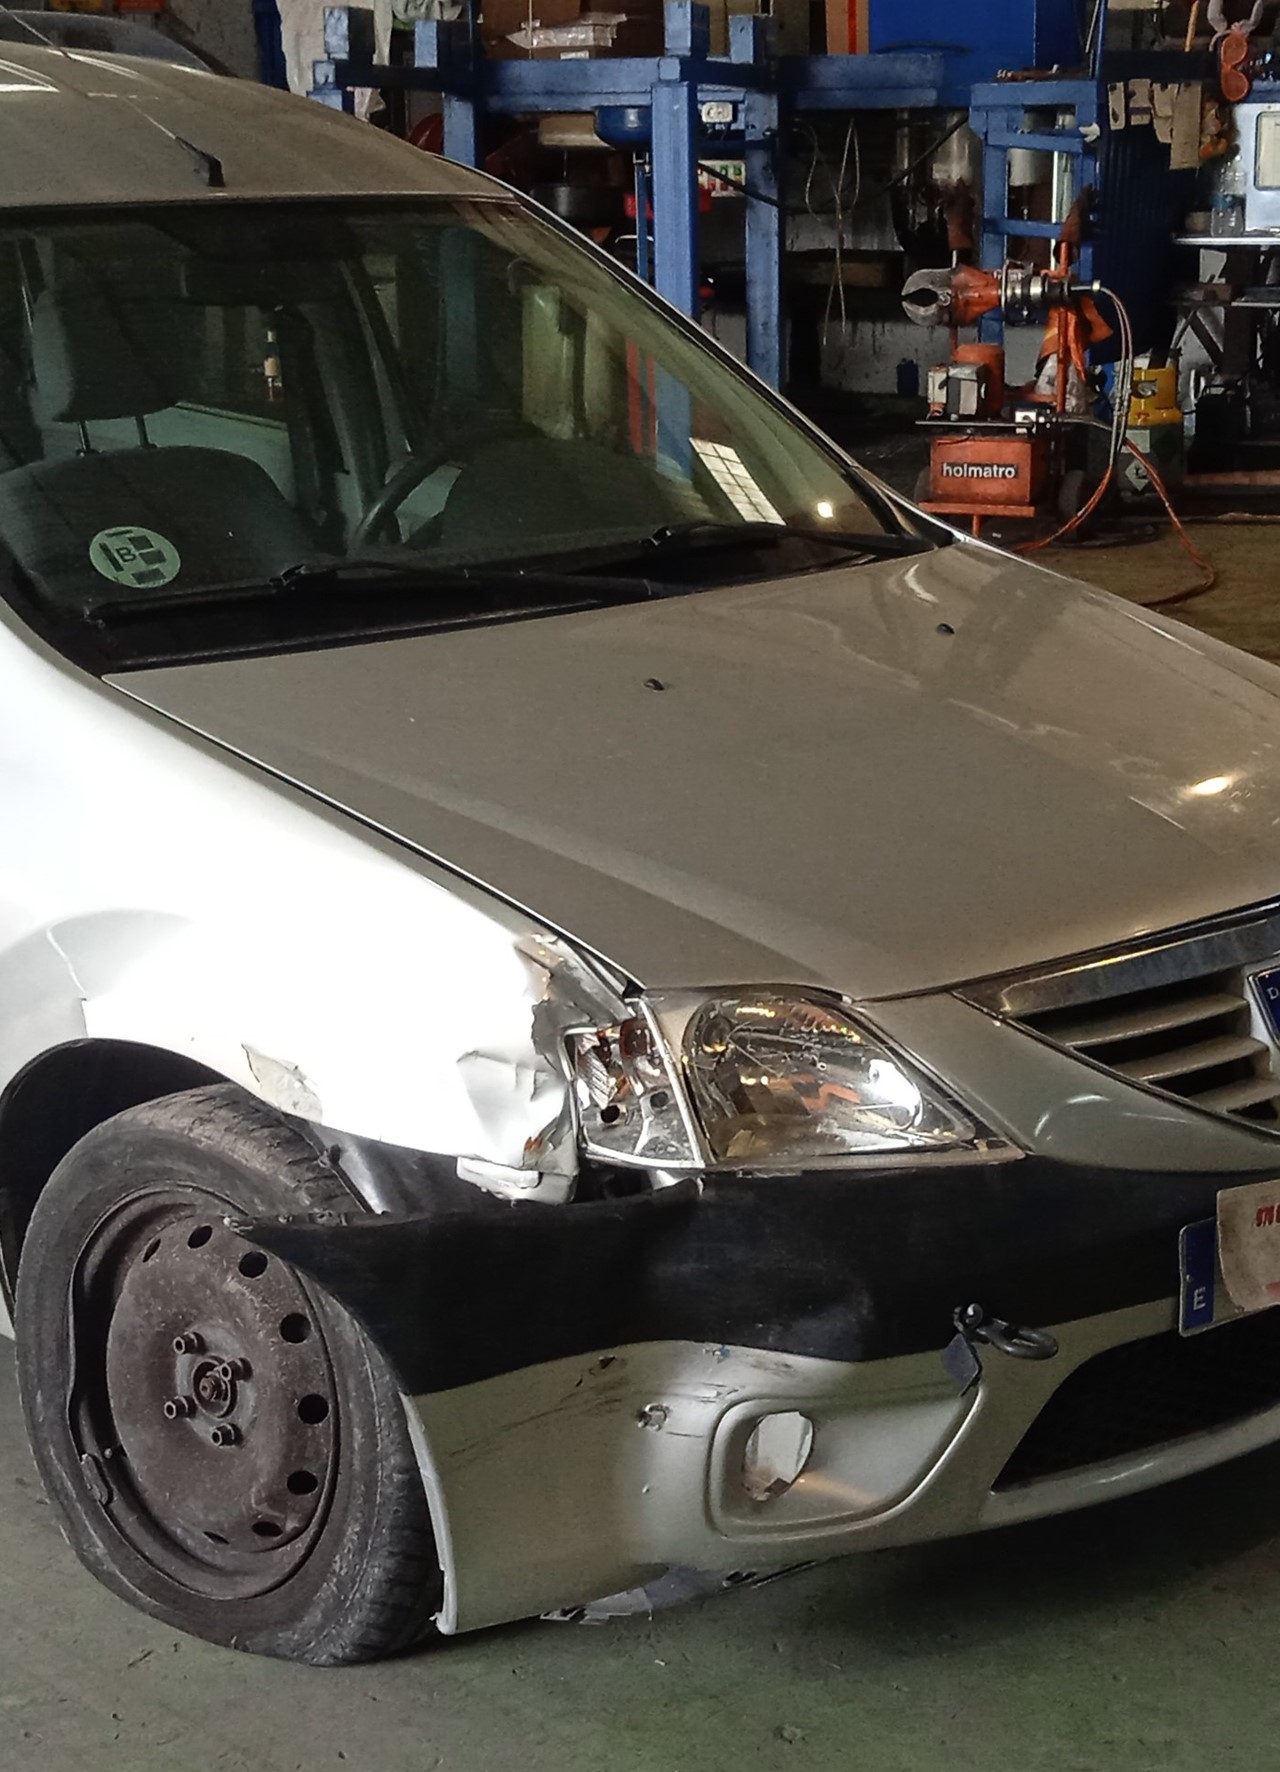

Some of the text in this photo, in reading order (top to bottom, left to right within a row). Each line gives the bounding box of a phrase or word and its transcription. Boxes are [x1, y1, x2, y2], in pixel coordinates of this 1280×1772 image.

[942, 462, 1016, 479] holmatro
[115, 546, 137, 563] B
[1193, 1286, 1207, 1311] E
